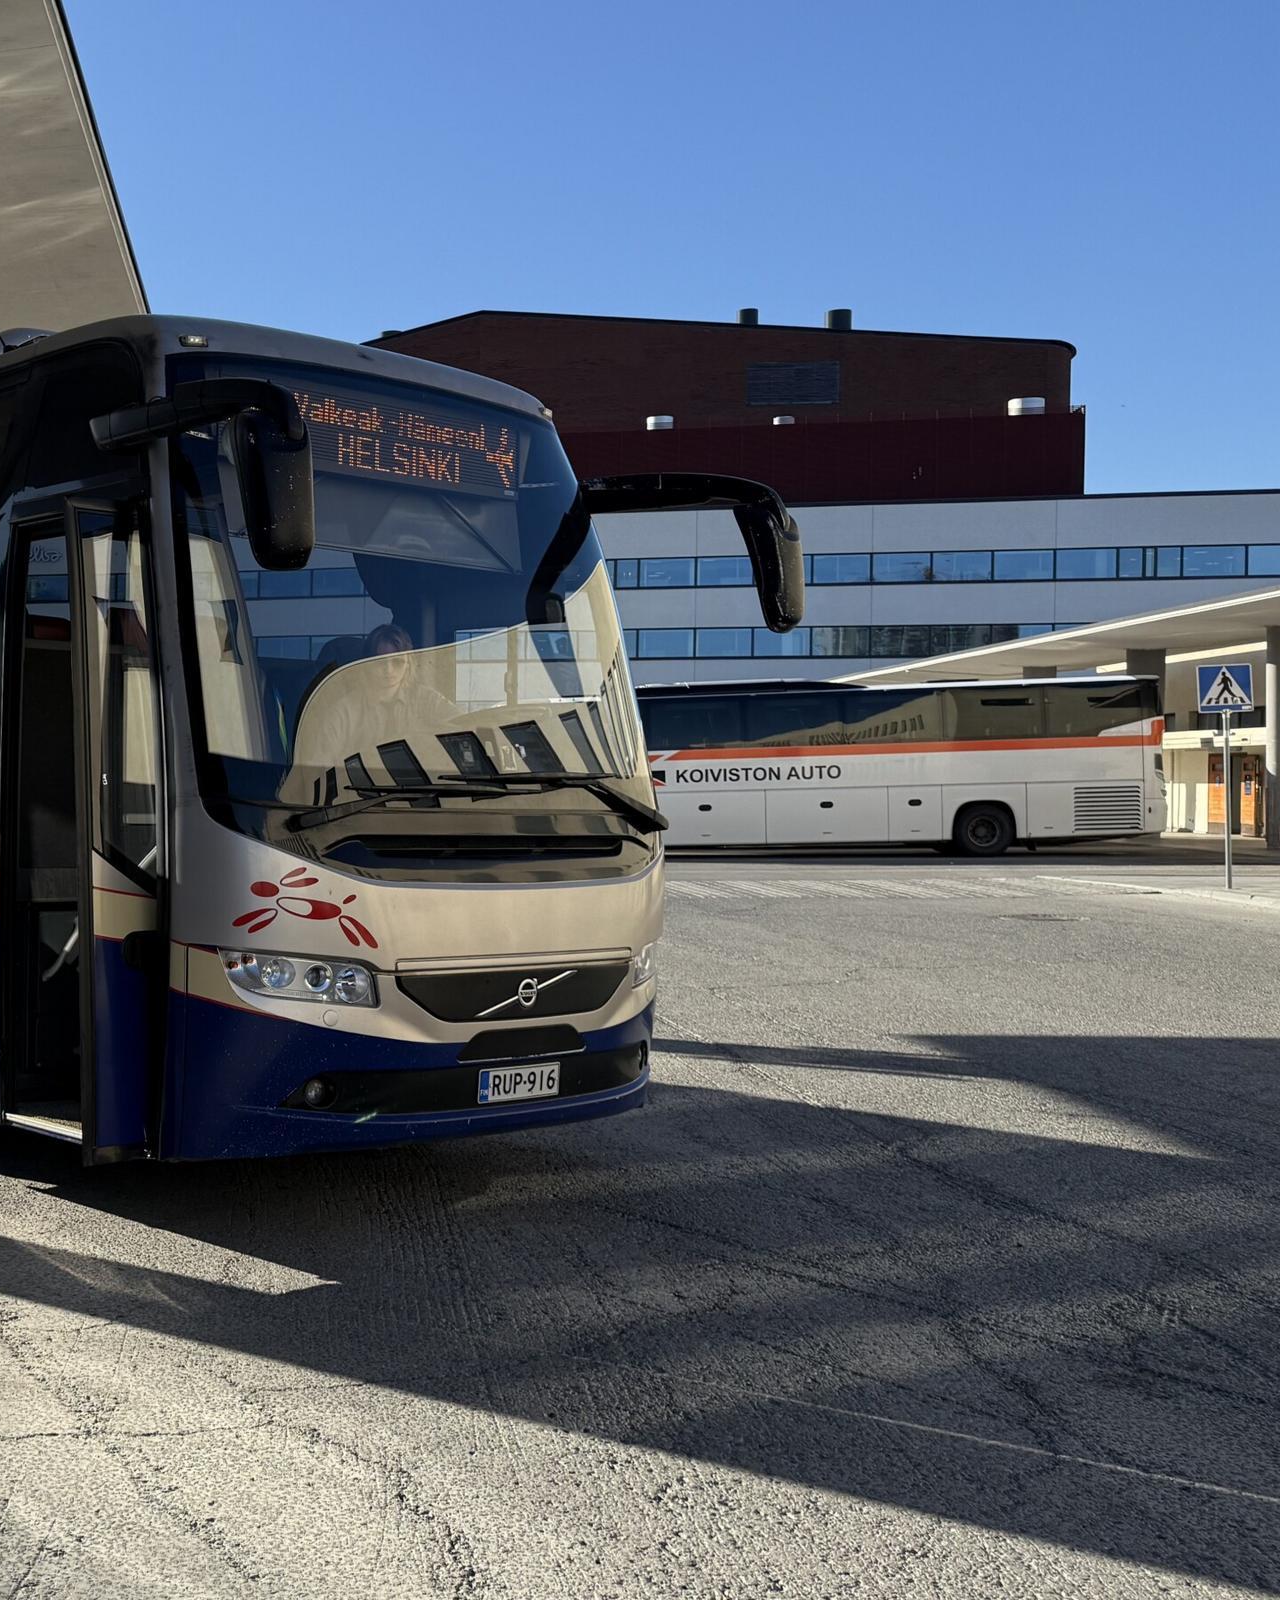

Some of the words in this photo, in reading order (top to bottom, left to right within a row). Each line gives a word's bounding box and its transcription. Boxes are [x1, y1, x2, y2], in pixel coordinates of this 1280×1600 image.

[338, 432, 461, 483] HELSINKI
[676, 766, 782, 783] KOIVISTON
[787, 765, 842, 780] AUTO
[491, 1069, 556, 1097] RUP-916
